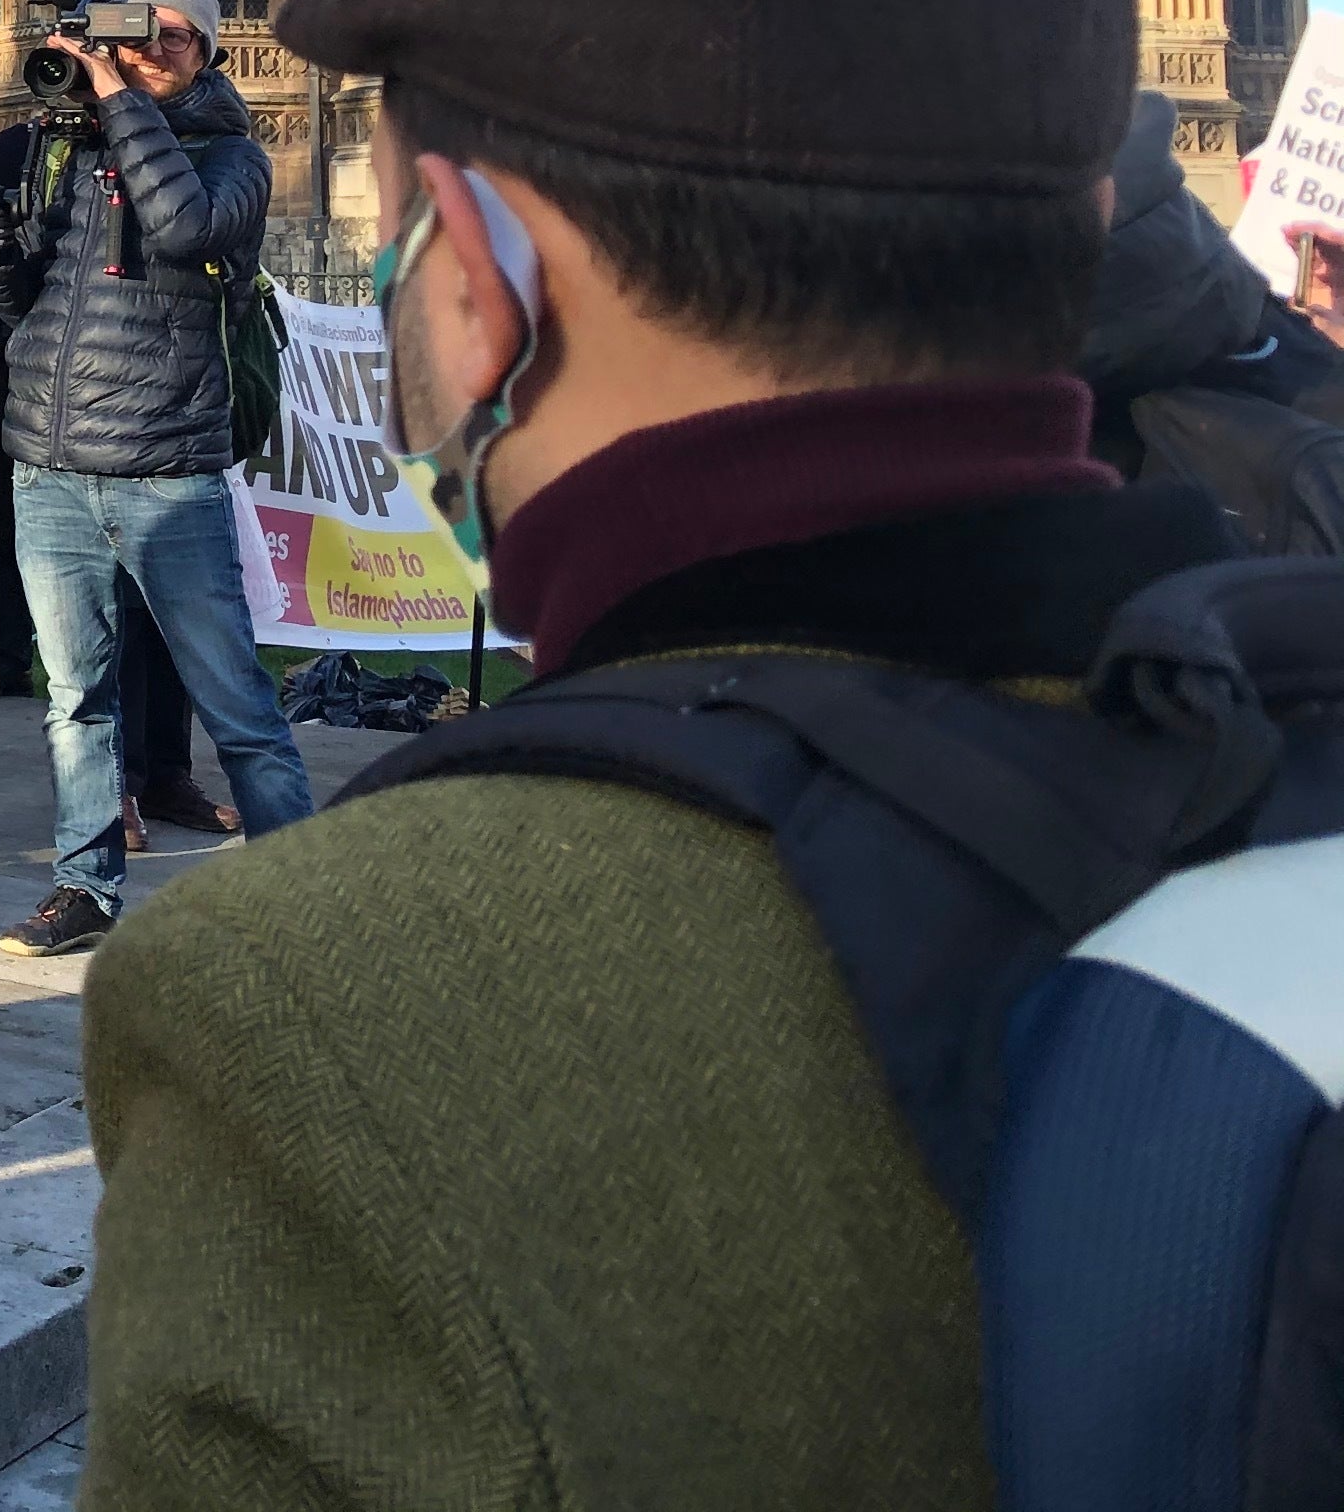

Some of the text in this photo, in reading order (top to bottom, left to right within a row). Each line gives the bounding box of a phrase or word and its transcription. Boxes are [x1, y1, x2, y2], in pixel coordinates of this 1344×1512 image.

[1270, 168, 1289, 198] &
[328, 433, 400, 518] UP
[348, 536, 425, 582] Say no to
[327, 580, 468, 629] Islamophobia
